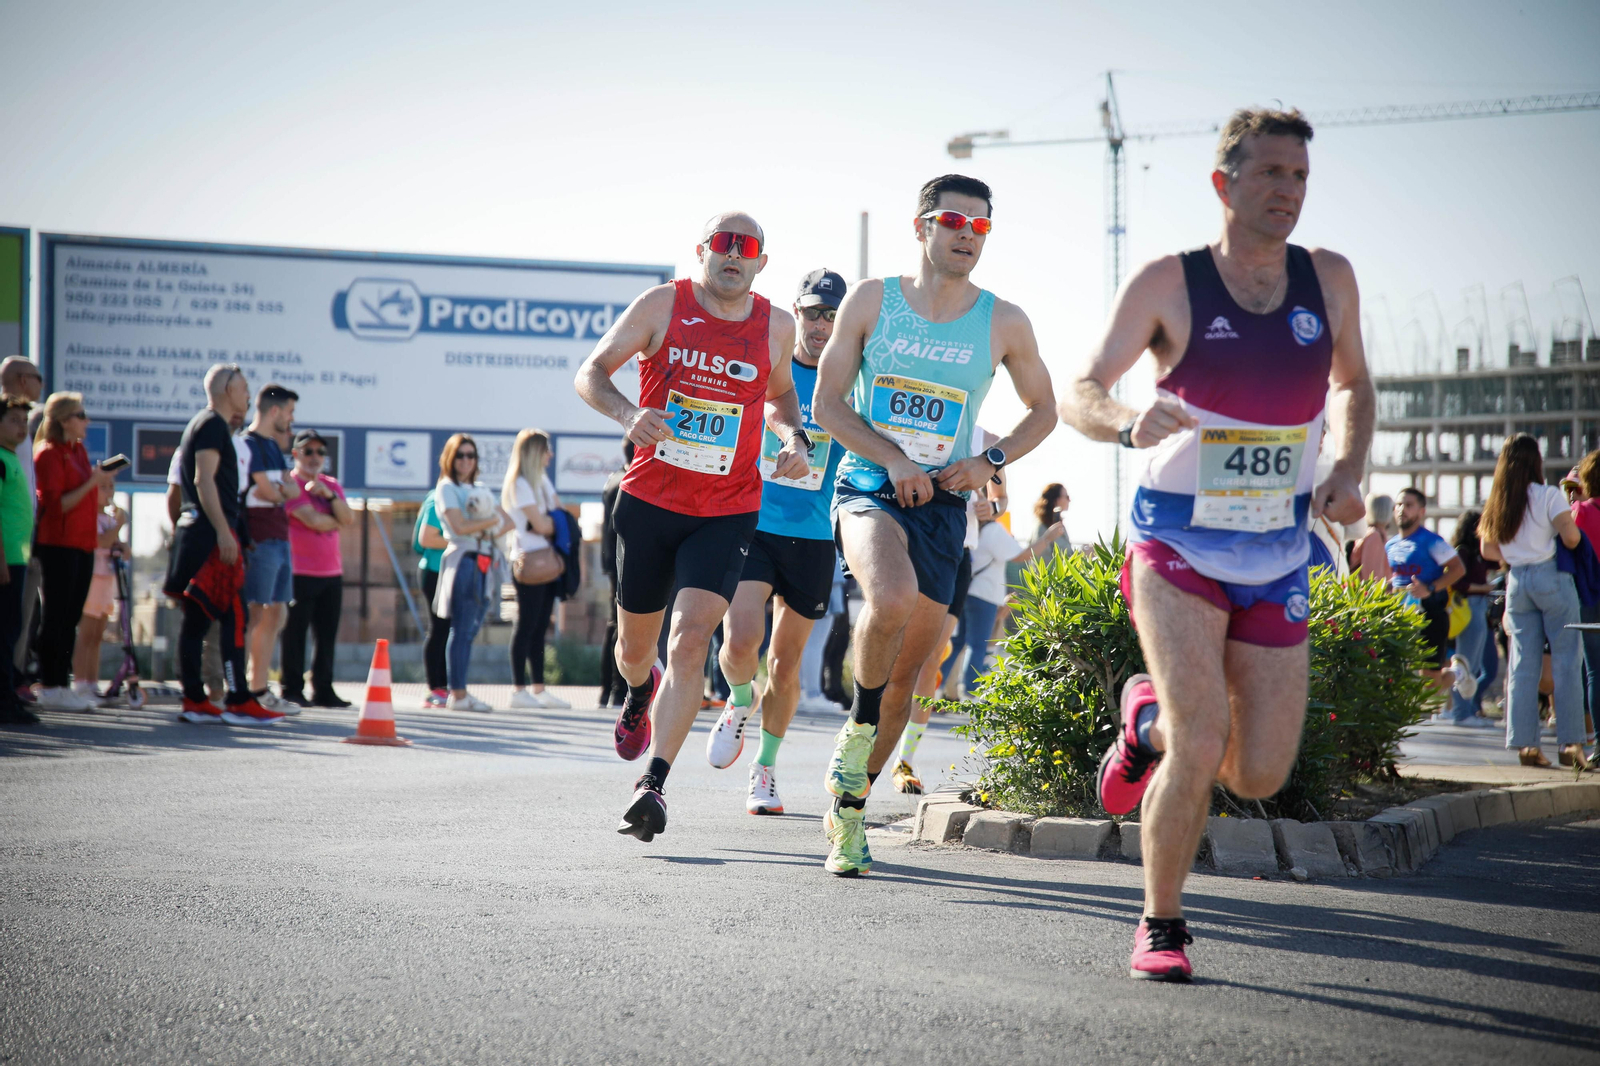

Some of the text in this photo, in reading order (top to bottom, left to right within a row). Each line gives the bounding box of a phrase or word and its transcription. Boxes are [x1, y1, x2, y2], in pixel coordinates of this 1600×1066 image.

[897, 332, 974, 349] CLUB DEPORTIVO
[889, 338, 974, 364] RAICES
[444, 352, 569, 369] DISTRIBUIDOR
[691, 373, 728, 388] RUNNING
[888, 390, 945, 423] 680
[677, 408, 726, 436] 210
[888, 415, 913, 426] JESUS
[914, 419, 938, 431] LOPEZ
[679, 430, 697, 440] PACO
[698, 434, 717, 443] CRUZ
[1223, 446, 1292, 476] 486
[1212, 477, 1246, 486] CURRO
[1249, 477, 1281, 487] HUETE
